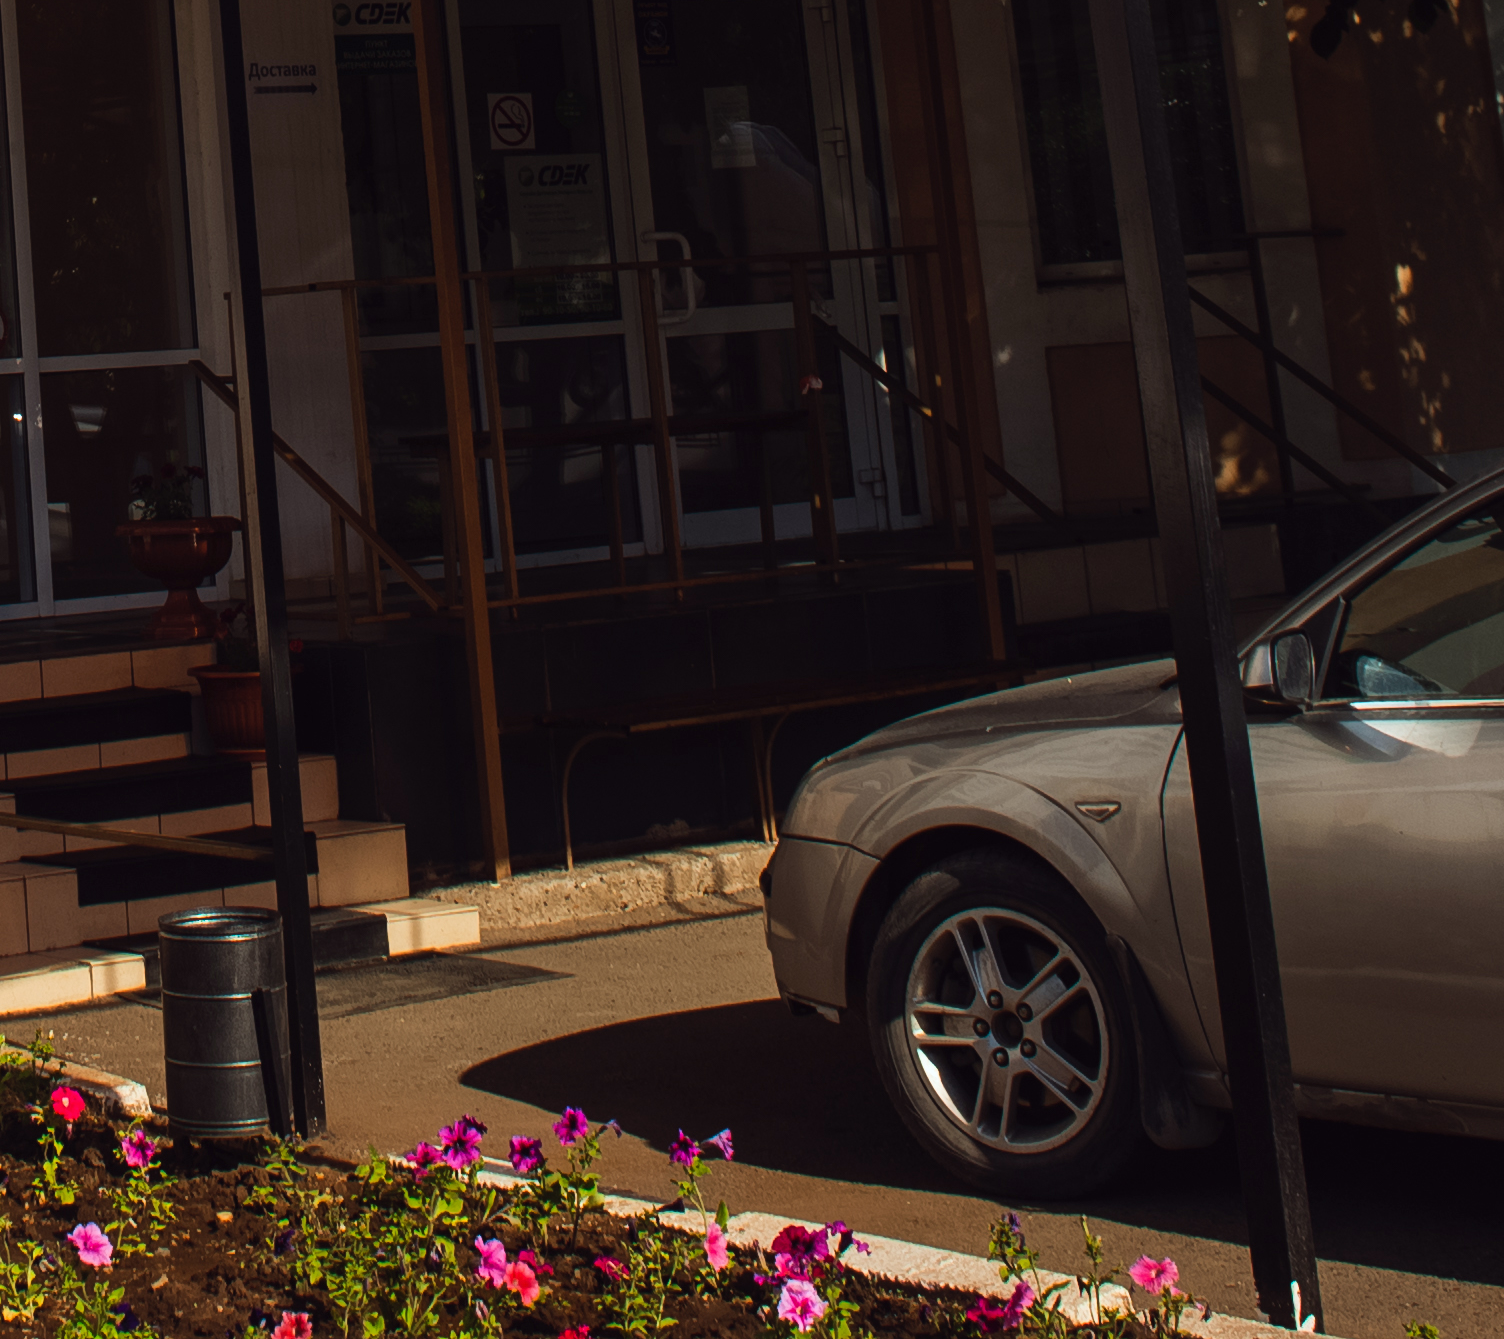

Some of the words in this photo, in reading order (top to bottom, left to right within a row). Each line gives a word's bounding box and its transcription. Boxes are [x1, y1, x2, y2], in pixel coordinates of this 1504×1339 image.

[354, 1, 412, 25] CDEK
[248, 62, 317, 81] Доставка
[537, 163, 591, 187] CDEK
